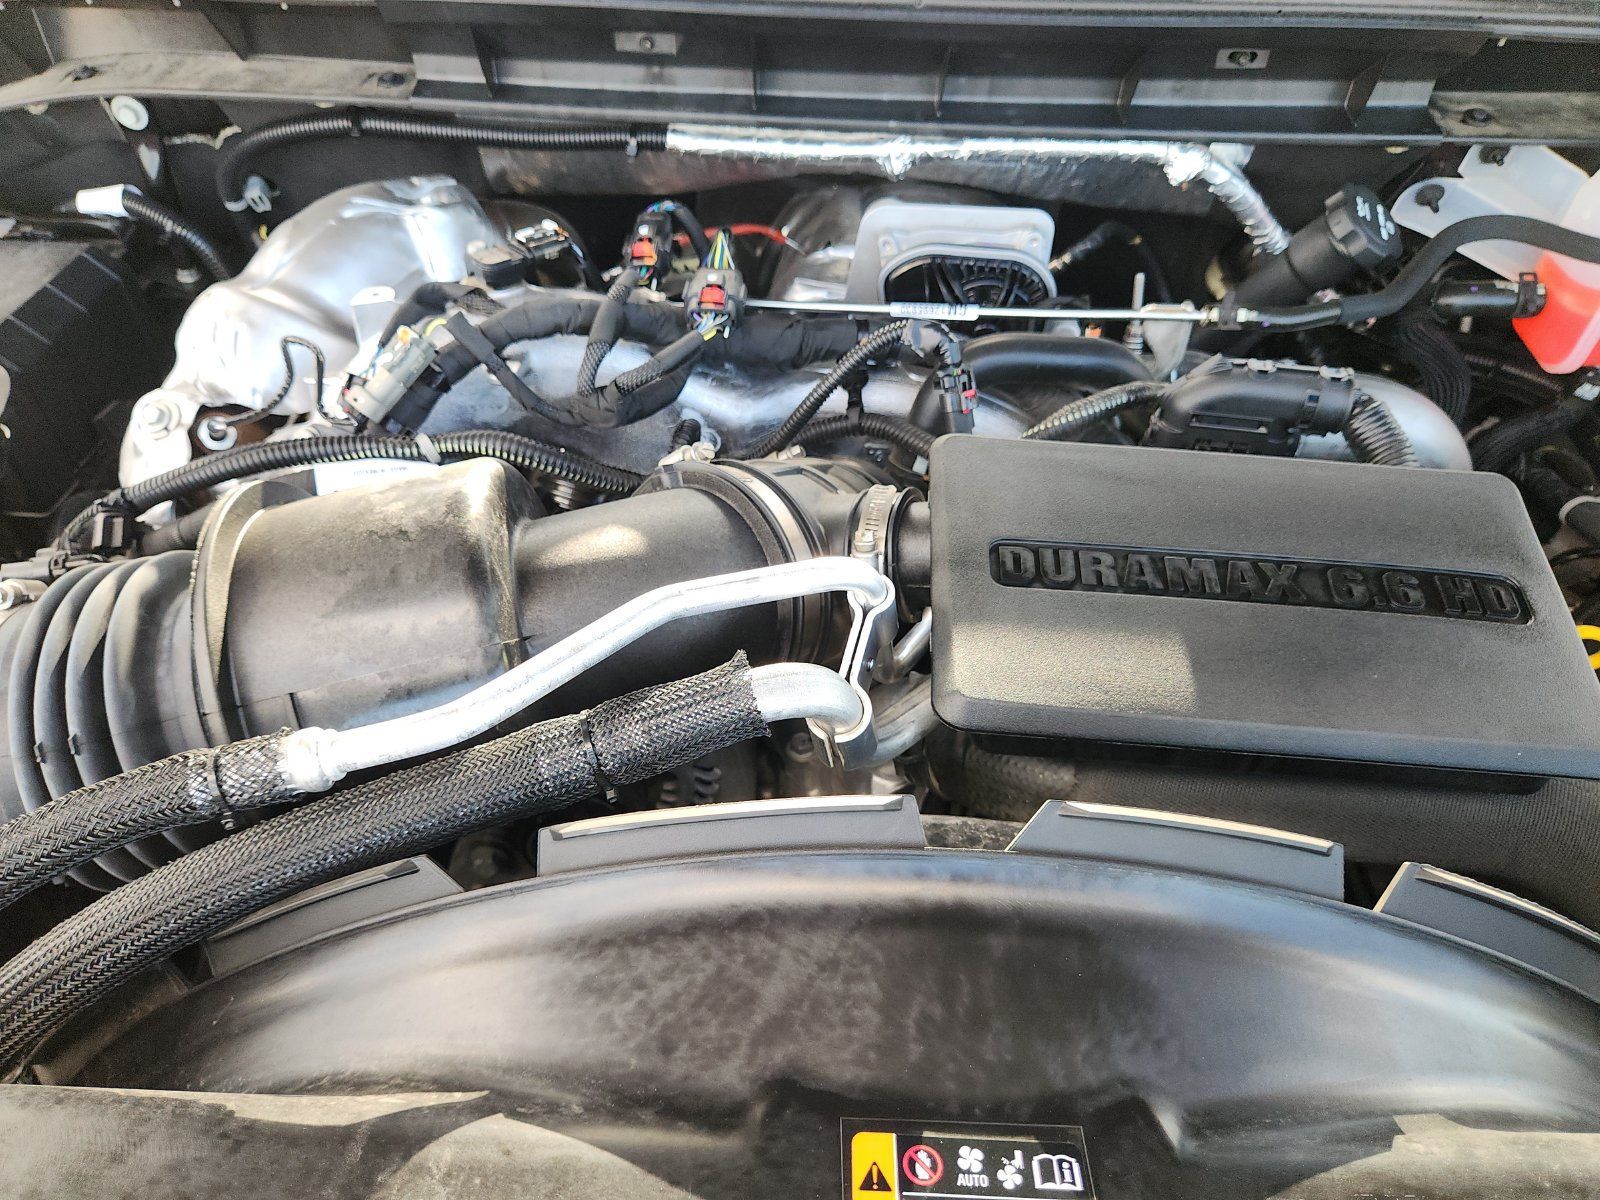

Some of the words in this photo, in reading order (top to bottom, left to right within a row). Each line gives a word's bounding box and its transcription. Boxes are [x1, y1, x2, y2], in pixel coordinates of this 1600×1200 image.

[998, 545, 1307, 600] DURAMAX
[1326, 567, 1425, 609] 6.6
[1434, 574, 1522, 619] HD
[956, 1172, 989, 1188] AUTO
